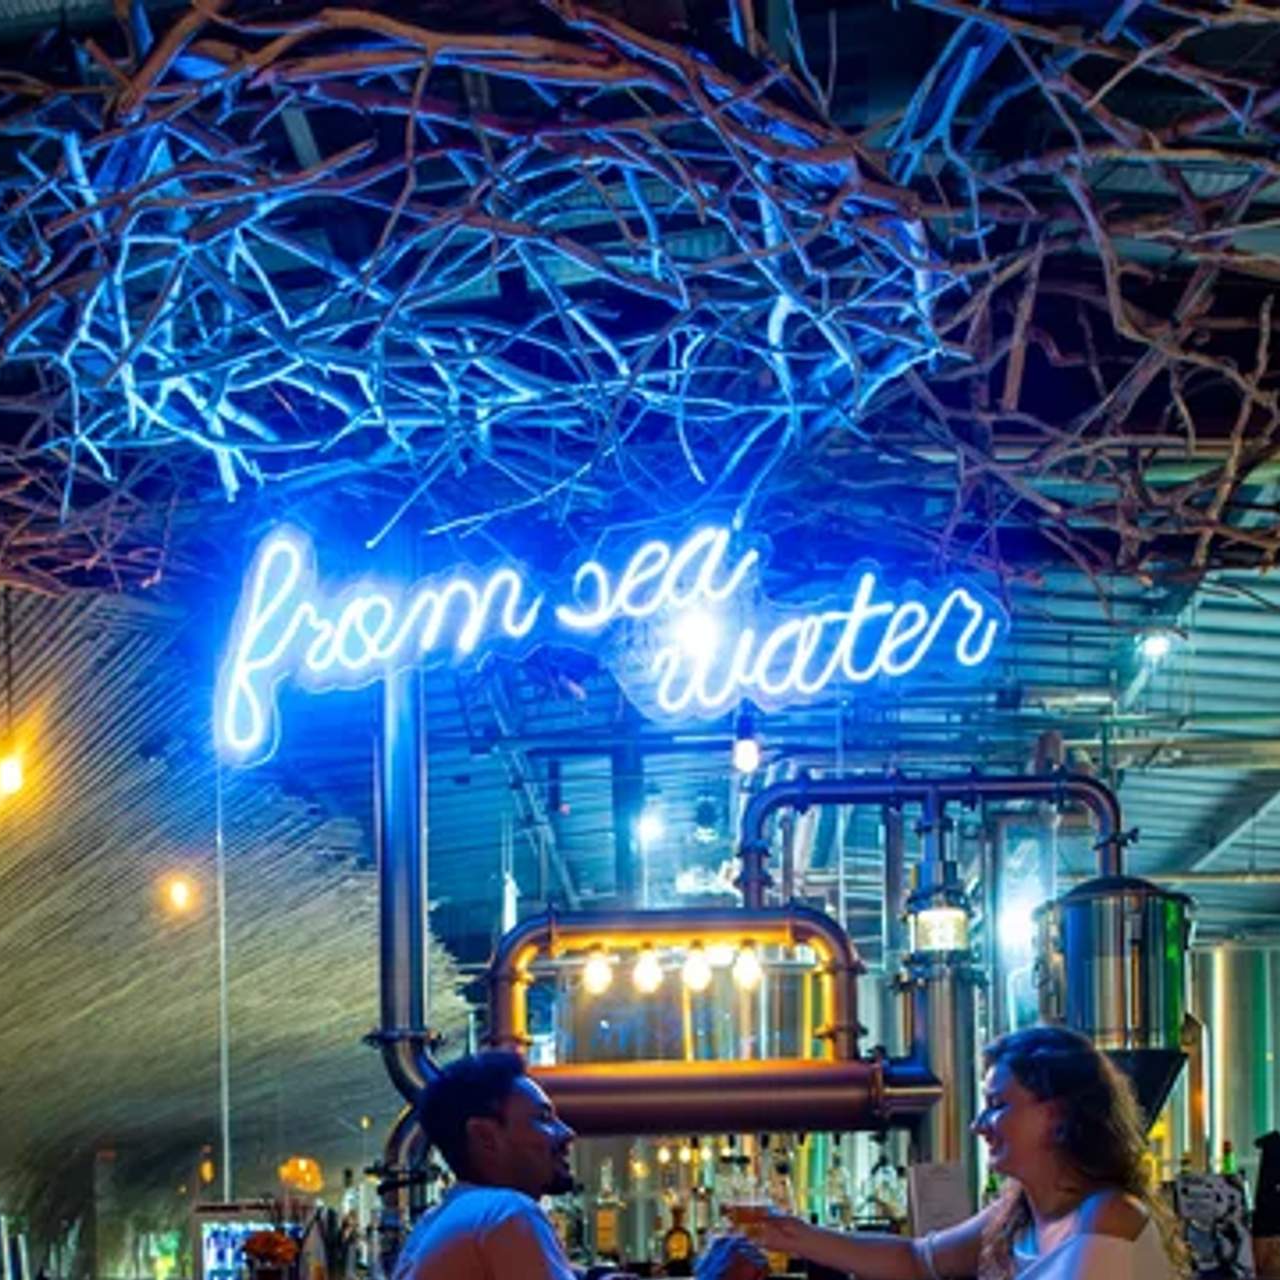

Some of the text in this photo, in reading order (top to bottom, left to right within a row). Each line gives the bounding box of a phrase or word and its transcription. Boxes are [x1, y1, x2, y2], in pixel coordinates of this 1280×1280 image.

[222, 527, 760, 751] from sea
[655, 572, 998, 713] water
